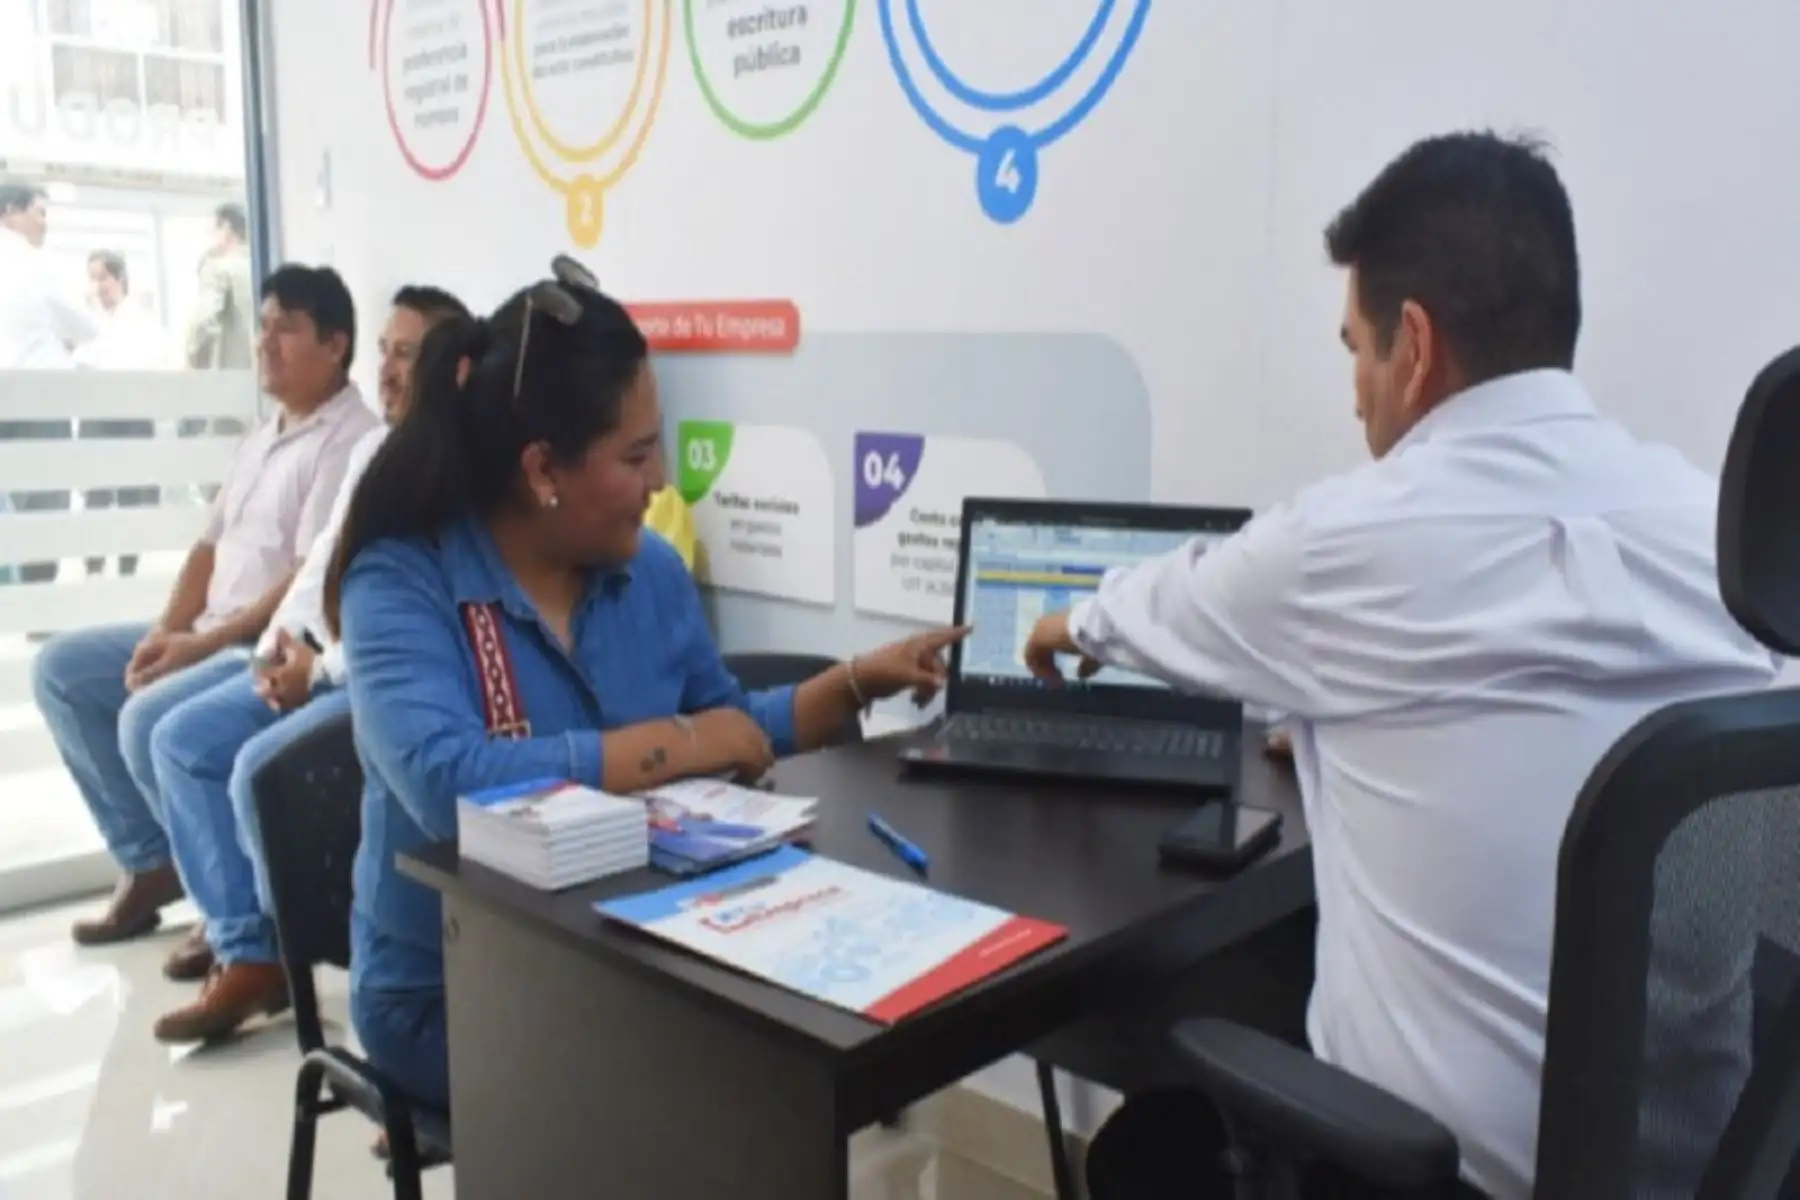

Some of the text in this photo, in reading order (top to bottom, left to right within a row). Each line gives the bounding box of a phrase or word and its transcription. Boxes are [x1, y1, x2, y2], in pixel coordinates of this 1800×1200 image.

[726, 4, 808, 40] escritura
[995, 147, 1021, 194] 4
[716, 312, 786, 340] Empresa
[688, 438, 717, 471] 03
[864, 450, 905, 491] 04
